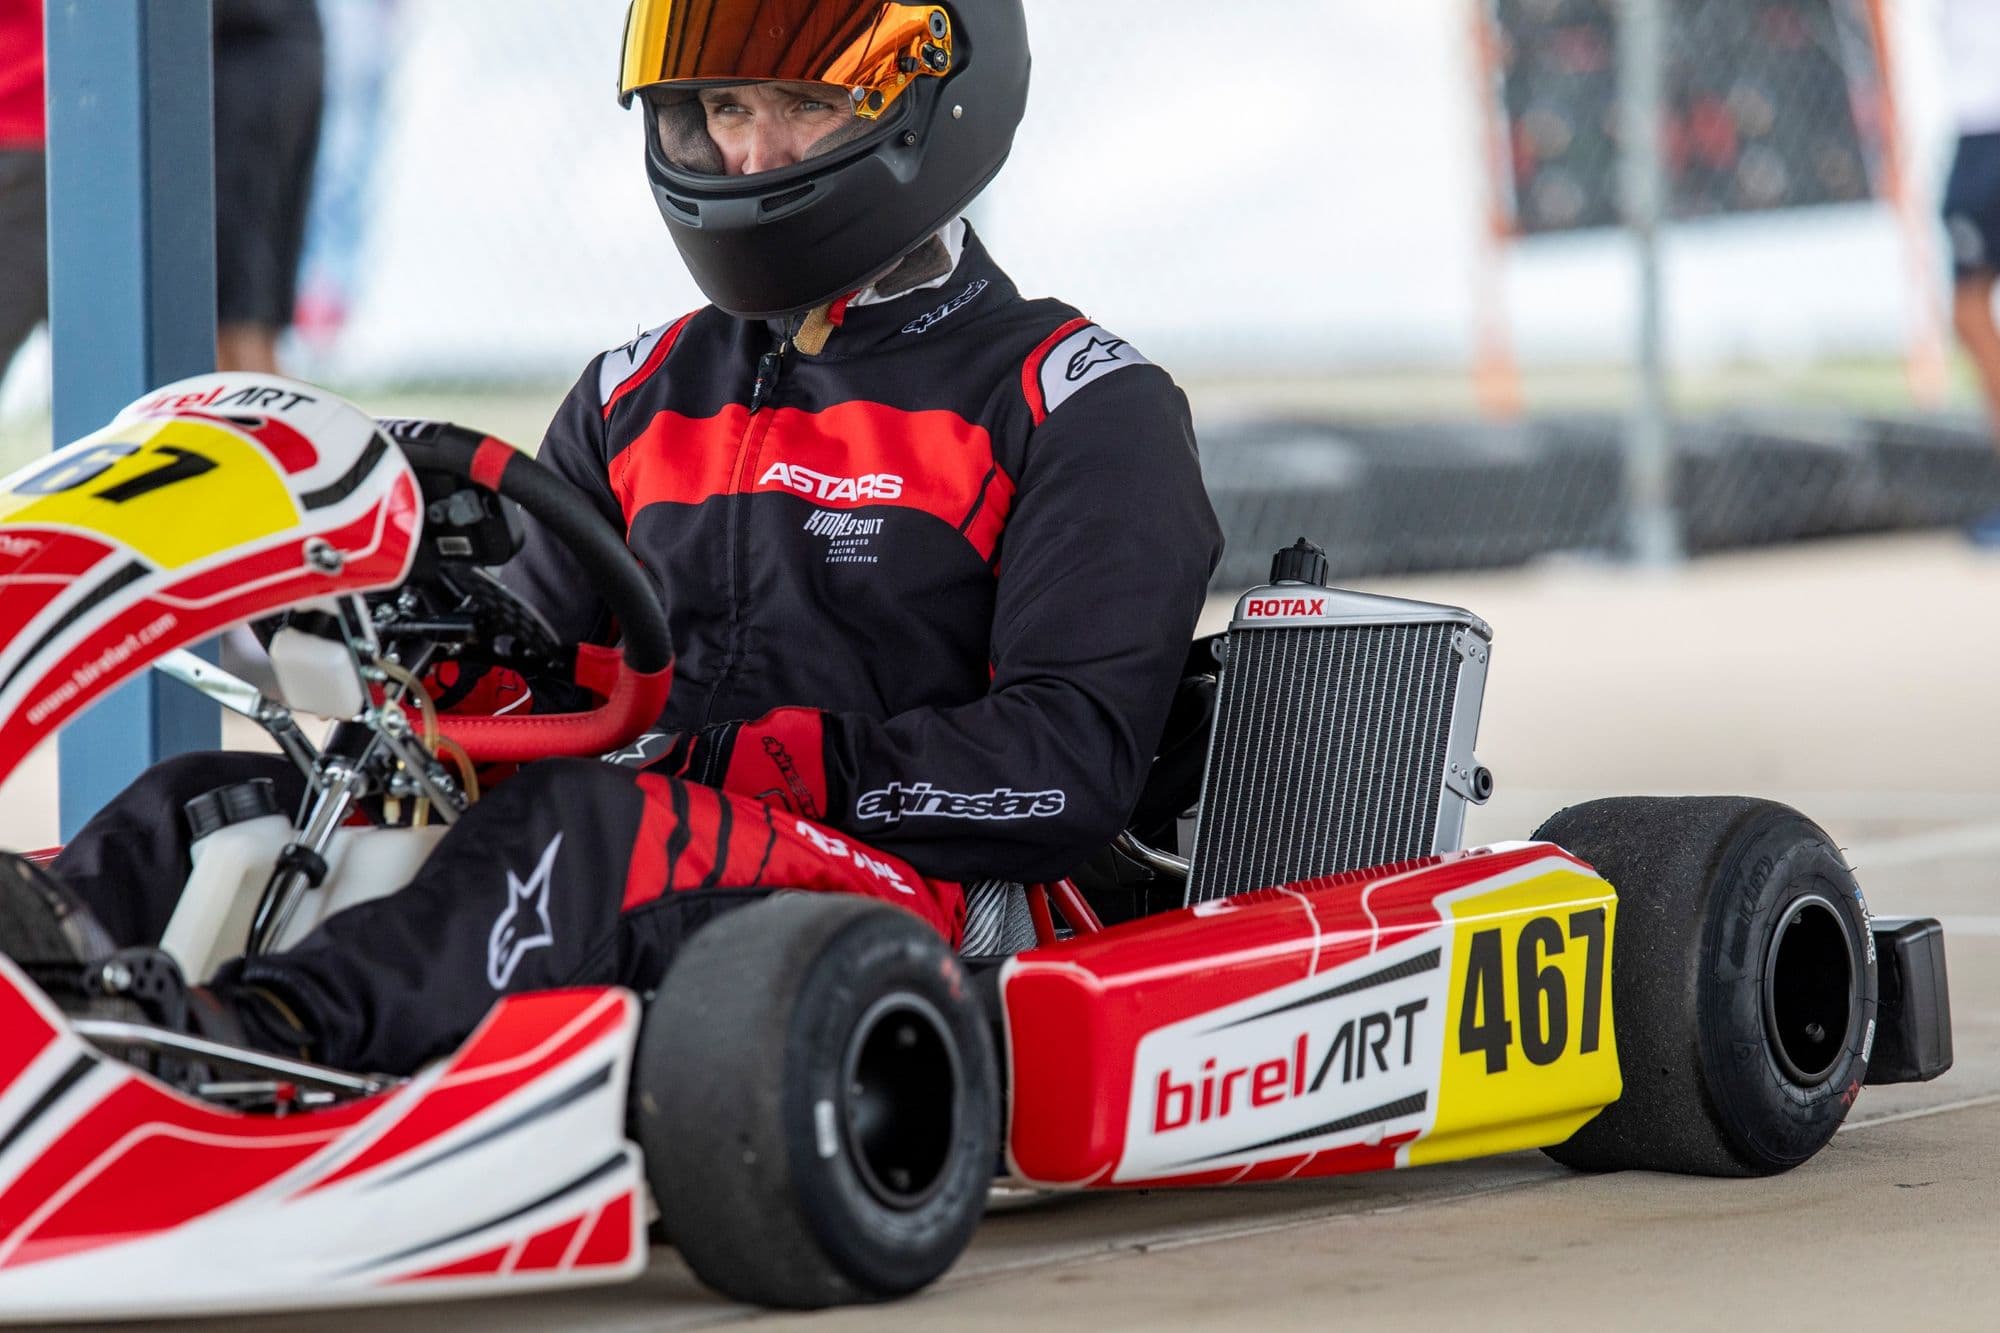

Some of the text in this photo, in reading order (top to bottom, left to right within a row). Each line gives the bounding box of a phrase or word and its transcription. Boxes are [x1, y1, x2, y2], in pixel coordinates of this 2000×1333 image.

[758, 462, 904, 502] ASTARS
[828, 547, 856, 555] RACING
[831, 538, 869, 547] ADVANCED
[825, 555, 878, 563] ENGINEERING
[1247, 599, 1325, 617] ROTAX
[856, 782, 1066, 823] alpinestars
[1459, 905, 1607, 1075] 467
[1153, 997, 1429, 1135] birelART
